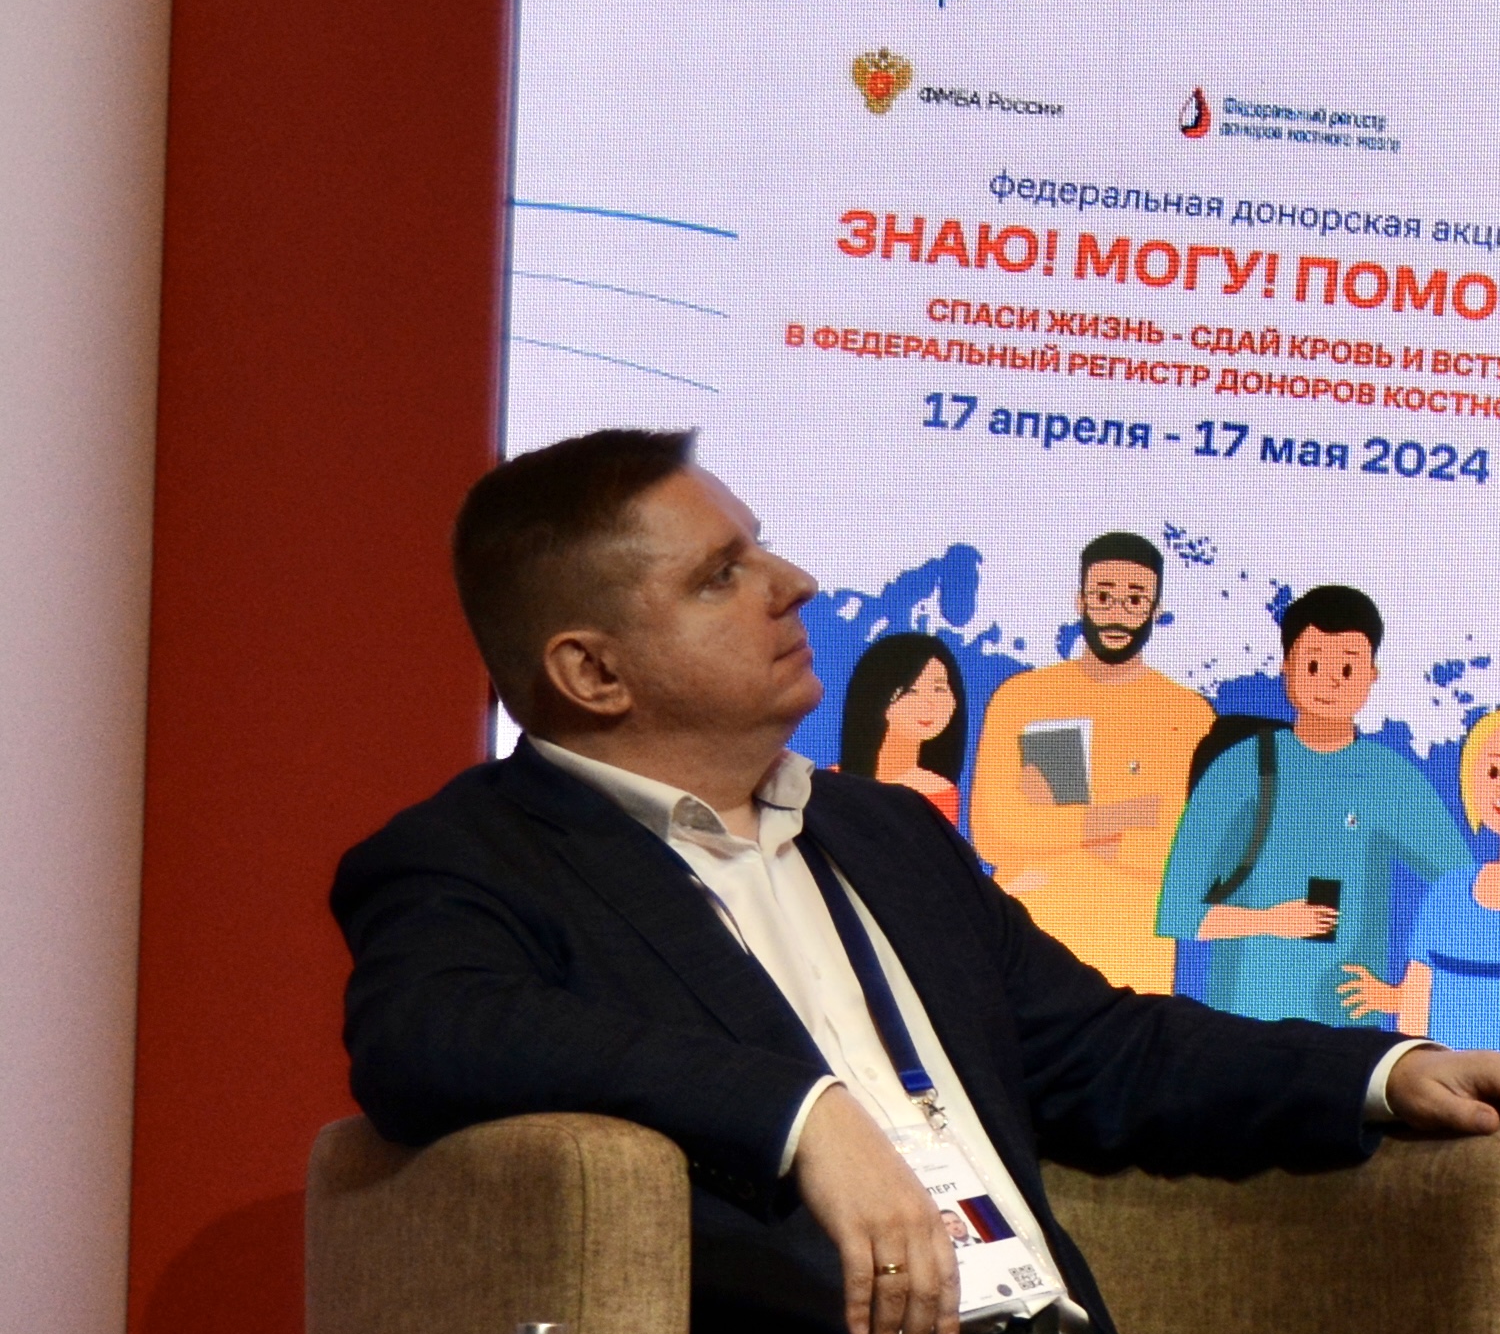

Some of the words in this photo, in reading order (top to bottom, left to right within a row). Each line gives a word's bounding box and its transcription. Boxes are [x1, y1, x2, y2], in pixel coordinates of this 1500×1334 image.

[989, 168, 1224, 218] федеральная
[1231, 196, 1422, 240] донорская
[836, 209, 1059, 277] ЗНАЮ!
[1073, 232, 1279, 299] МОГУ!
[784, 323, 807, 347] В
[811, 325, 1061, 373] ФЕДЕРАЛЬНЫЙ
[1067, 350, 1211, 388] РЕГИСТР
[1214, 367, 1376, 405] ДОНОРОВ
[926, 297, 1040, 333] СПАСИ
[1046, 308, 1165, 345] ЖИЗНЬ
[1190, 322, 1281, 358] СДАЙ
[1288, 334, 1394, 369] КРОВЬ
[1402, 346, 1424, 373] И
[922, 392, 979, 430] 17
[987, 408, 1152, 450] апреля
[1194, 419, 1249, 459] 17
[1260, 434, 1349, 470] мая
[1360, 436, 1490, 483] 2024
